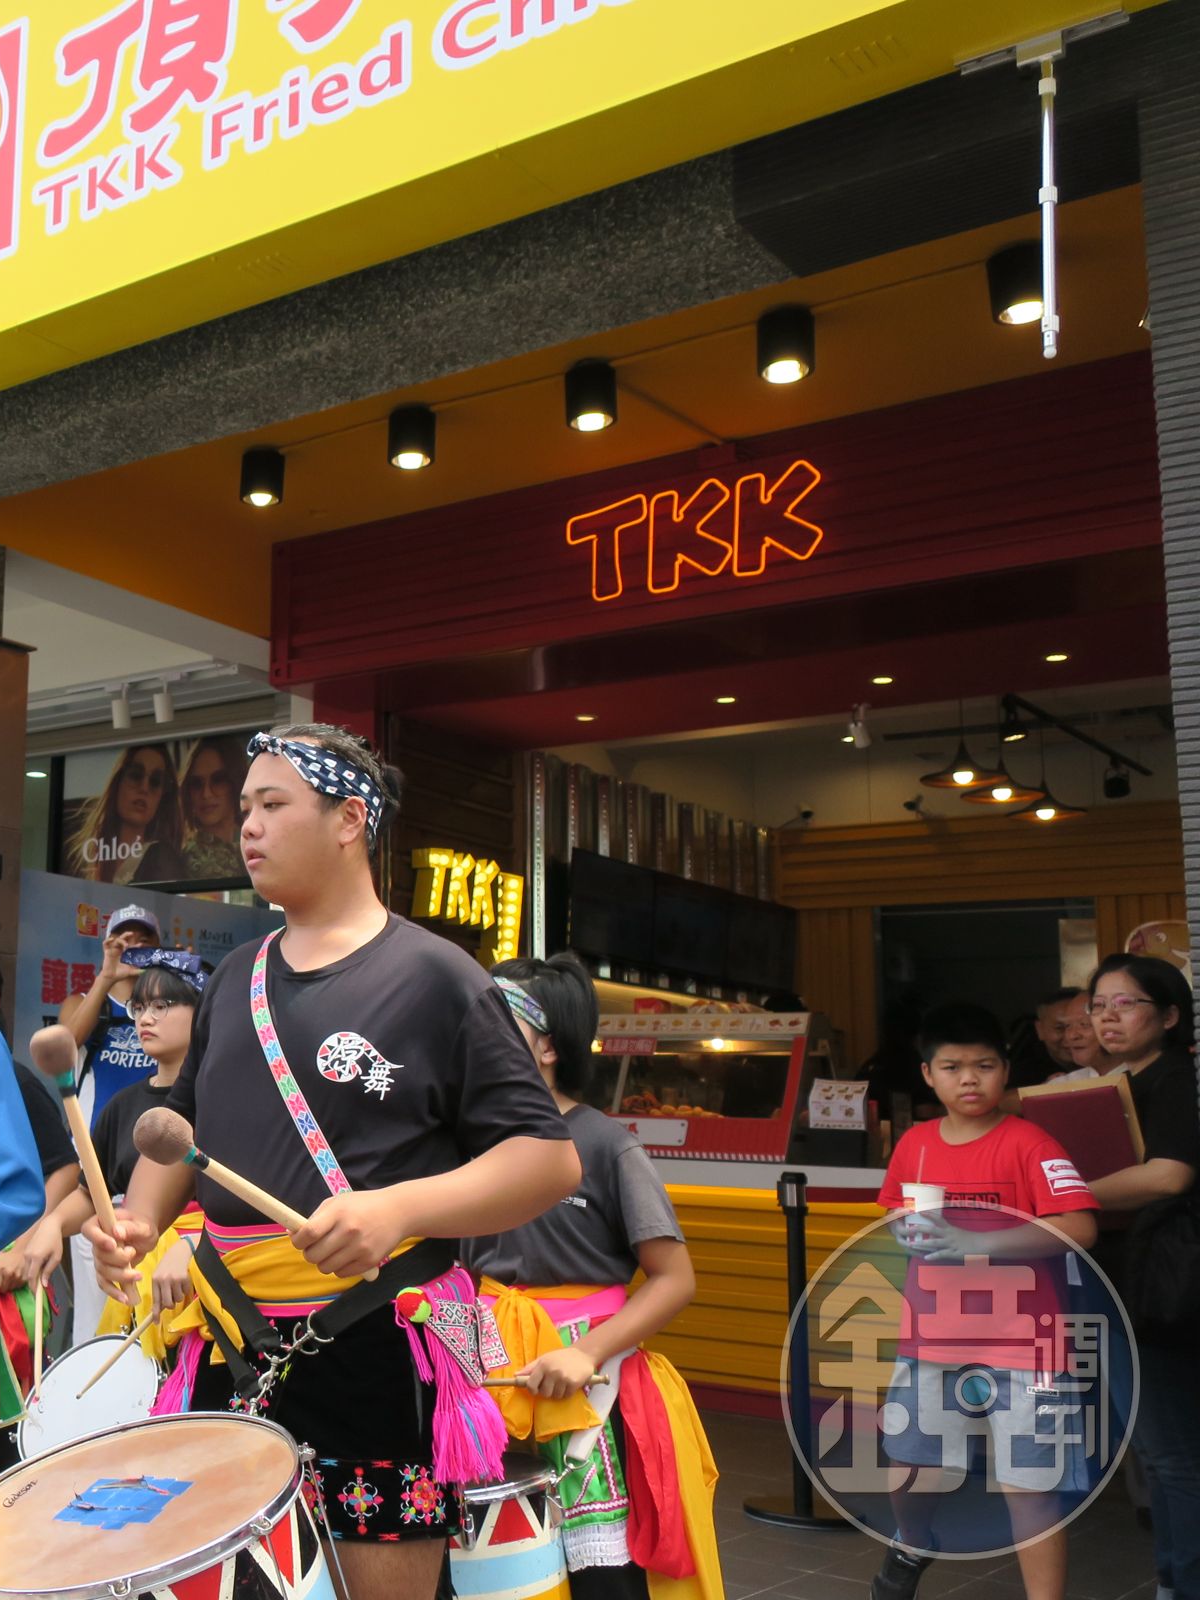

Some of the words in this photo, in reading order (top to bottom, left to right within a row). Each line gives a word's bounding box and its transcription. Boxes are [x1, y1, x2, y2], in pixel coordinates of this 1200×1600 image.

[38, 133, 174, 226] TKK
[211, 32, 403, 160] Fried
[567, 459, 823, 602] TKK
[82, 835, 144, 863] Chloé
[411, 847, 501, 930] TKK
[100, 1049, 158, 1068] PORTELA
